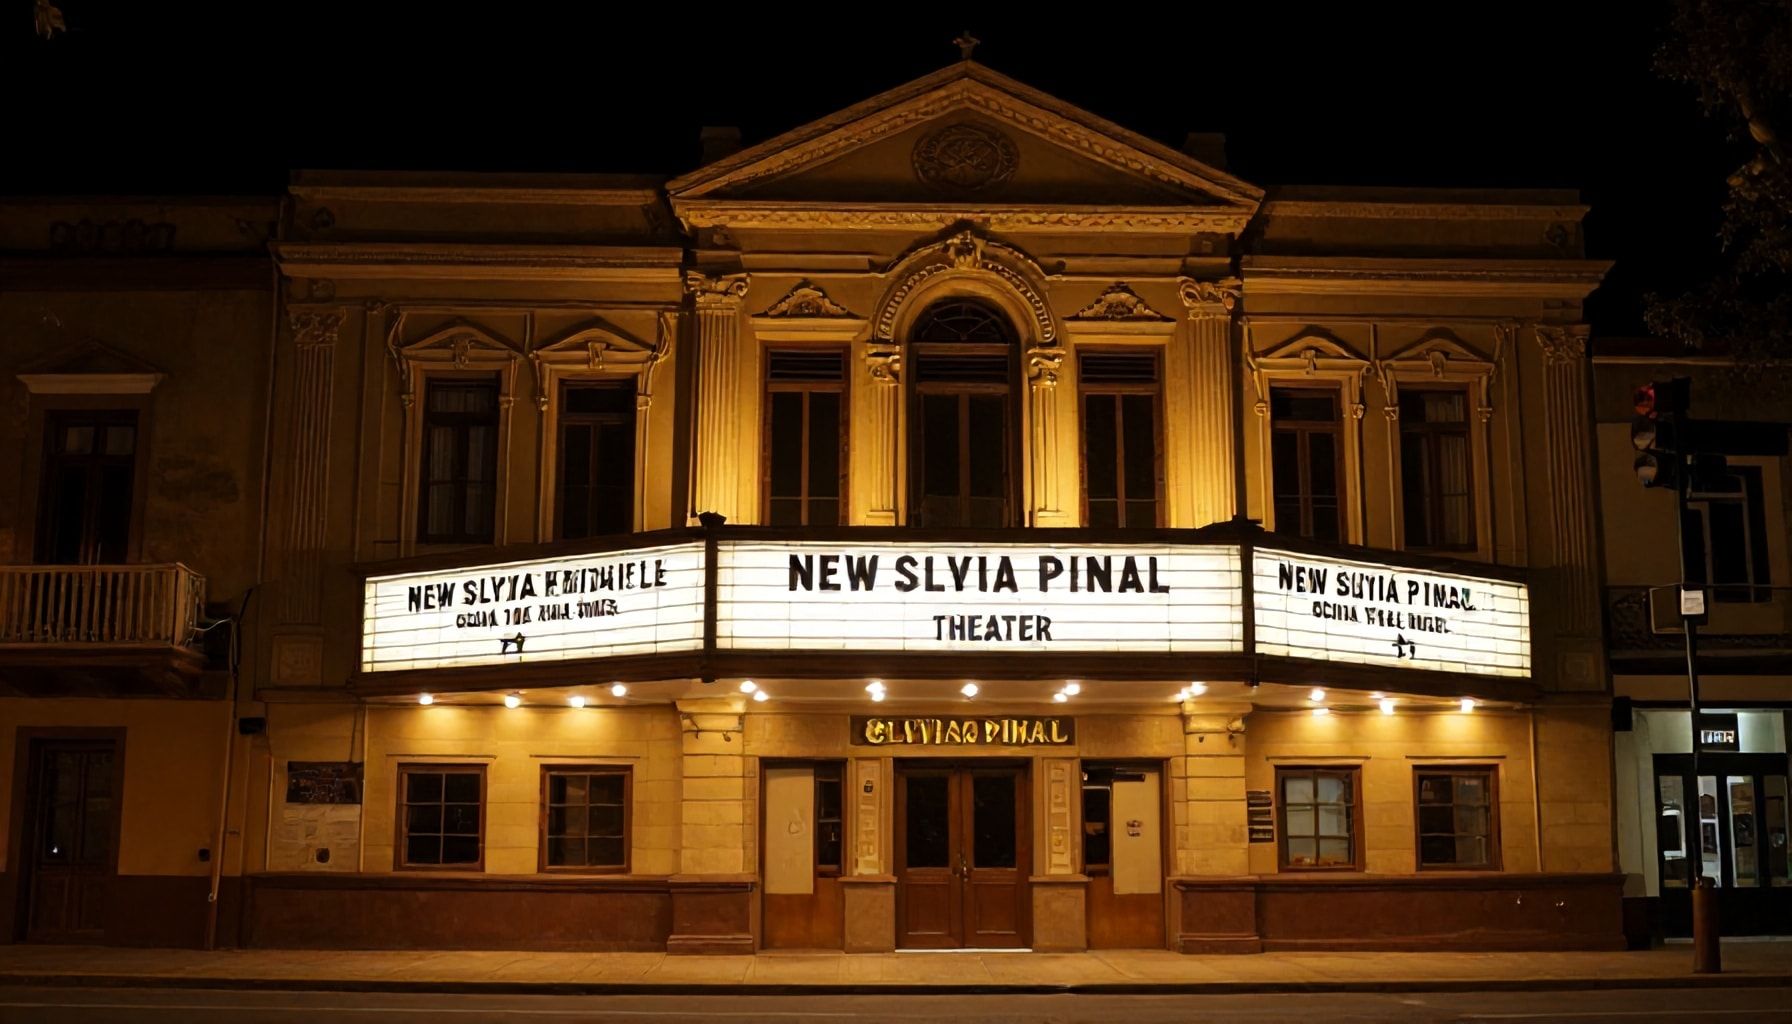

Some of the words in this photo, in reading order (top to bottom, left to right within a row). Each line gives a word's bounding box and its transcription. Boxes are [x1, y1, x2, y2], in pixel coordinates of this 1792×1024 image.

[789, 555, 878, 591] NEW
[1039, 556, 1170, 593] PINAL
[1279, 560, 1327, 594] NEW
[408, 582, 456, 613] NEW
[933, 614, 1052, 641] THEATER
